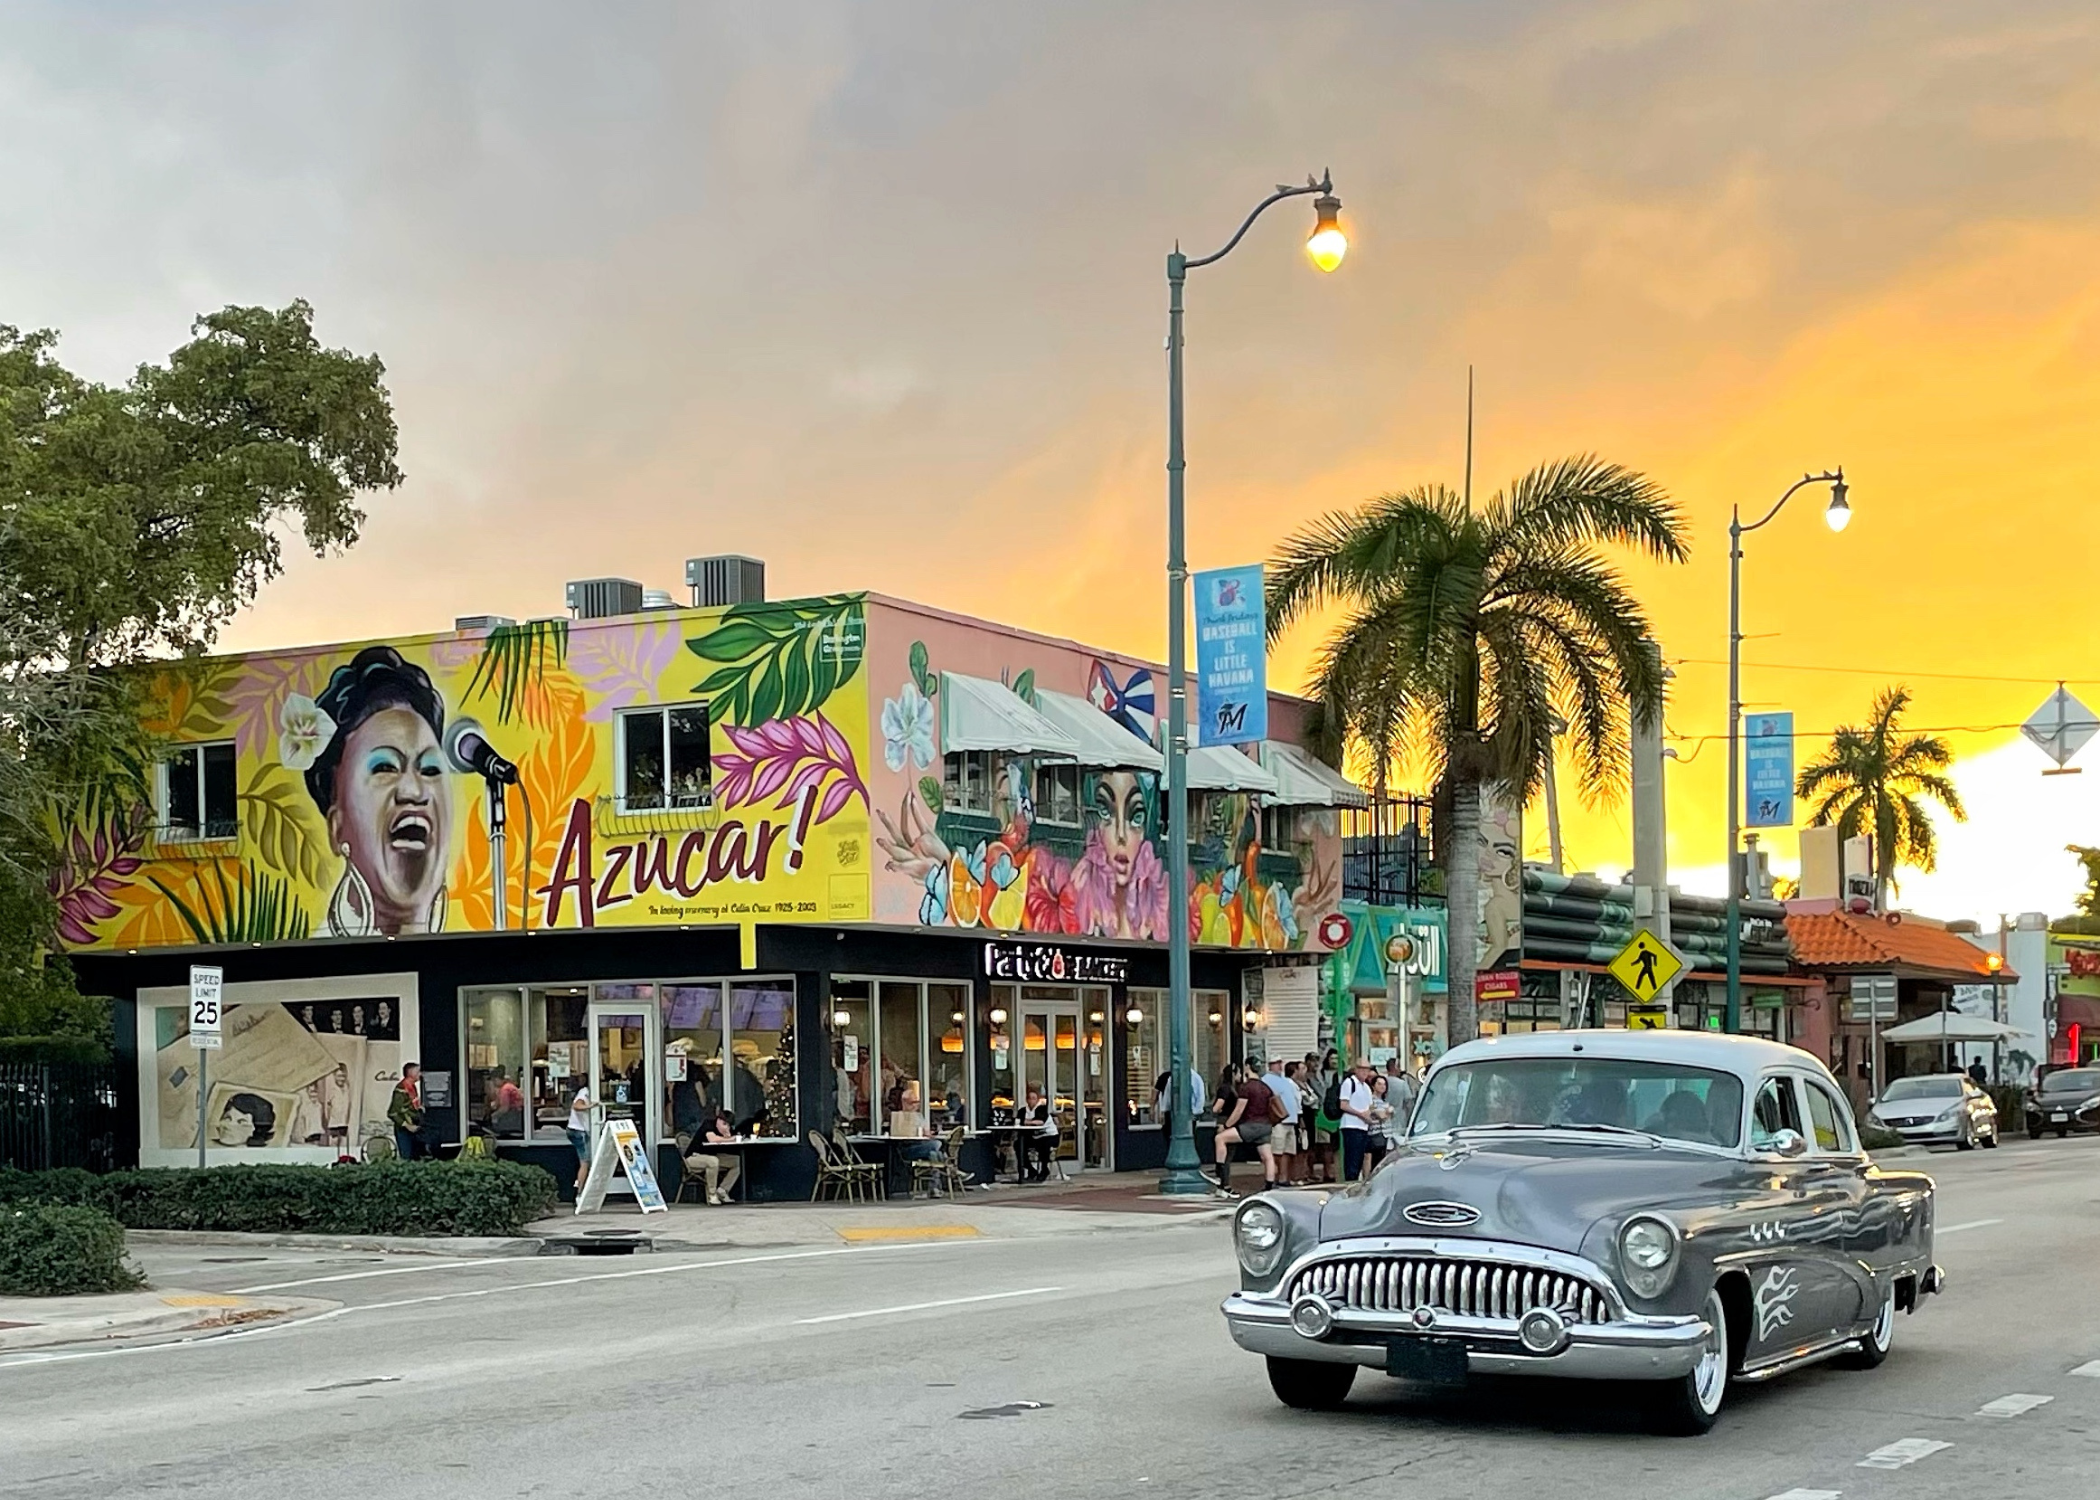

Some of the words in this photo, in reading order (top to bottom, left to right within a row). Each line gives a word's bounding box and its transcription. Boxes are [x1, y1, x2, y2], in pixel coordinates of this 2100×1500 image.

[1203, 622, 1257, 641] BASEBALL
[1225, 640, 1236, 654] IS
[1214, 654, 1249, 671] LITTLE
[1208, 668, 1254, 688] HAVANA
[659, 903, 684, 919] loving
[730, 902, 751, 914] Celia
[752, 901, 772, 914] Cruz
[193, 974, 220, 986] SPEED
[1484, 981, 1508, 990] CIGARS
[195, 987, 217, 998] LIMIT
[194, 1000, 218, 1025] 25
